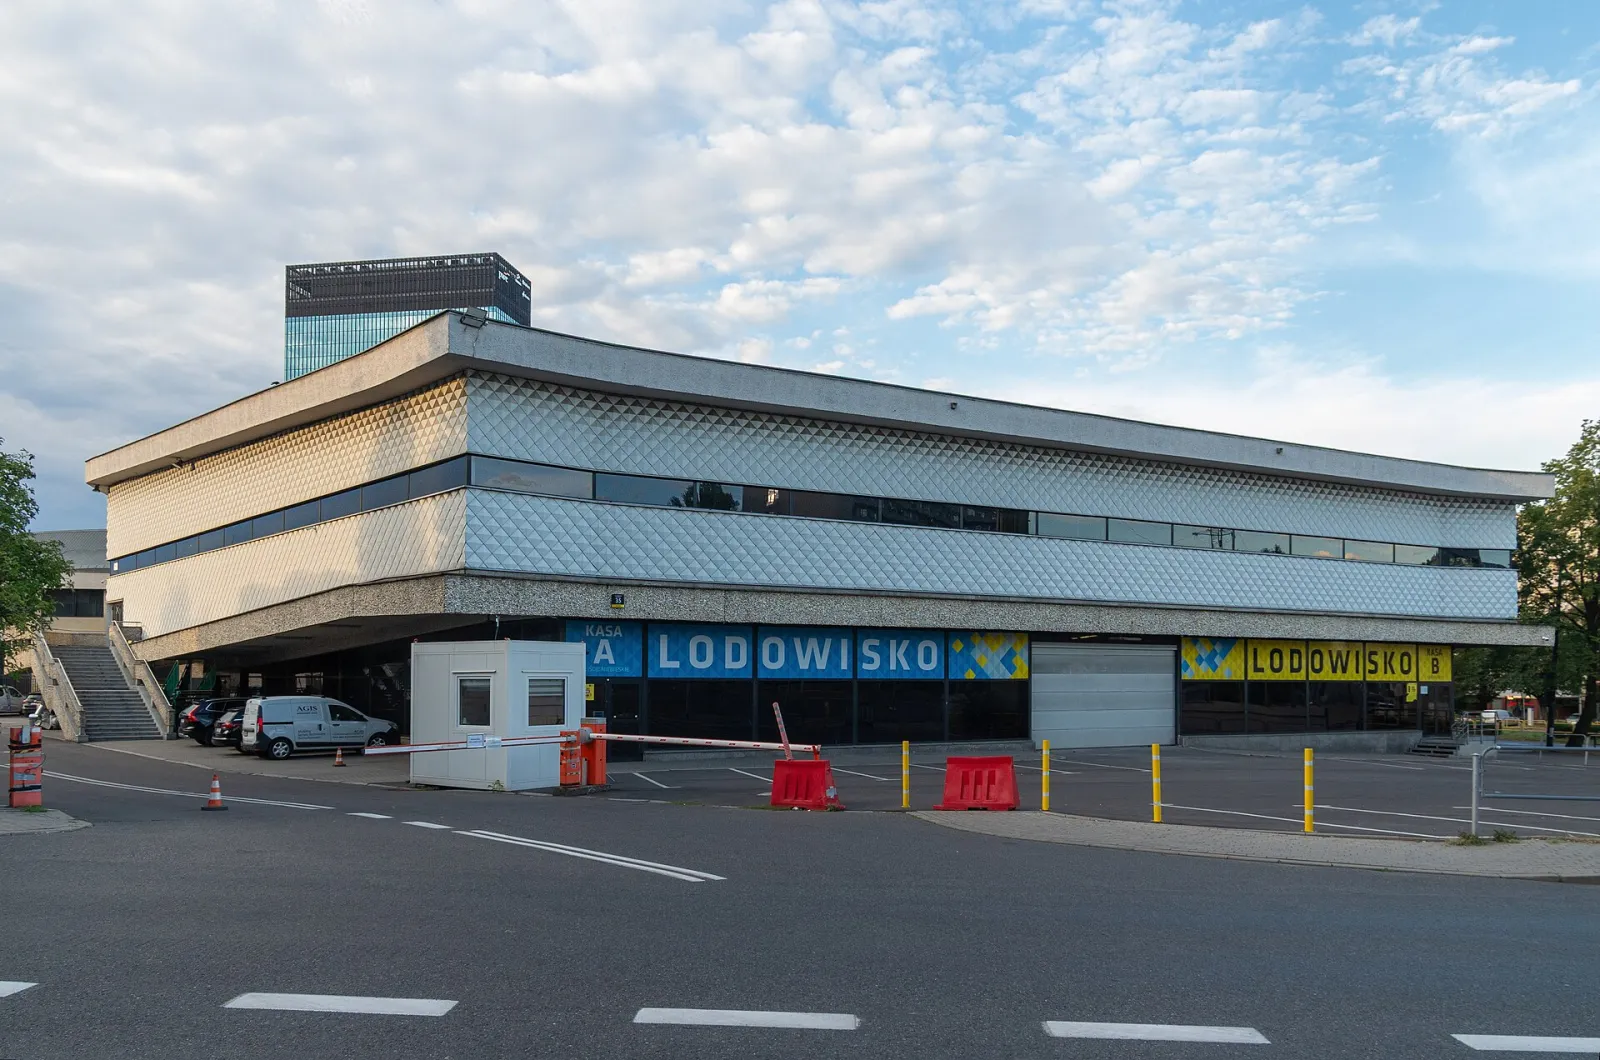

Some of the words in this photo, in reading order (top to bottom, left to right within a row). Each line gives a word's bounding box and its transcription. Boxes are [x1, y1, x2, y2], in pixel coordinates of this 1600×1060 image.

[585, 625, 623, 638] KASA
[593, 639, 615, 664] A
[659, 634, 938, 671] LODOWISKO
[1253, 647, 1412, 675] LODOWISKO
[1432, 658, 1440, 674] B
